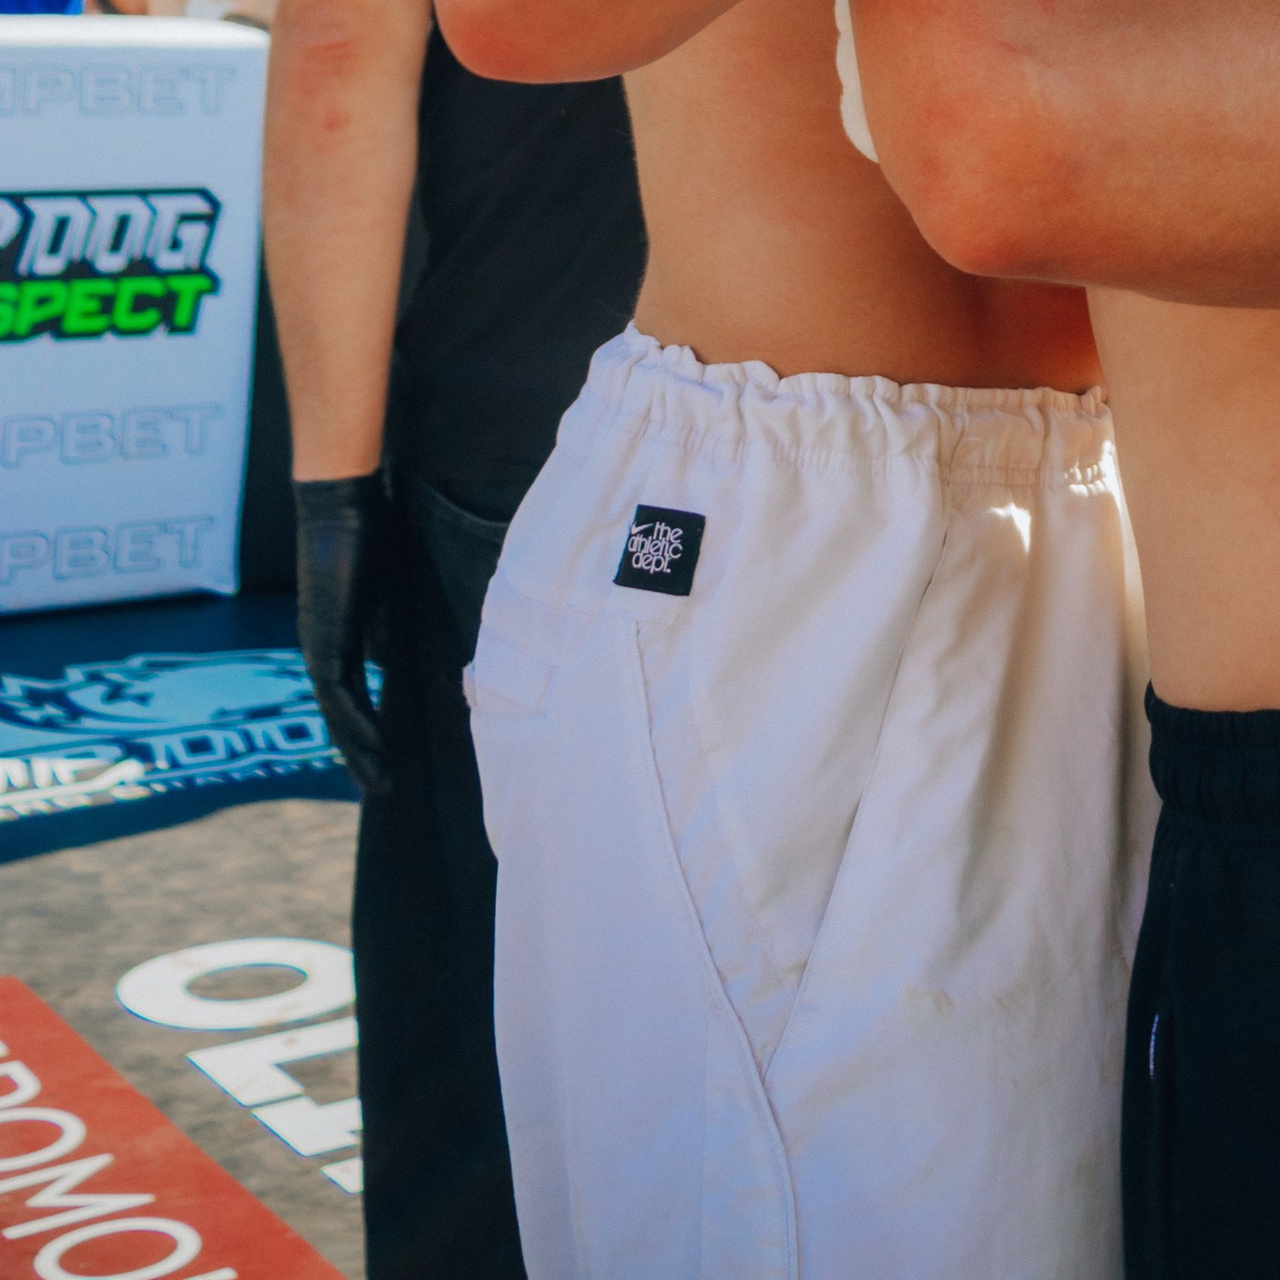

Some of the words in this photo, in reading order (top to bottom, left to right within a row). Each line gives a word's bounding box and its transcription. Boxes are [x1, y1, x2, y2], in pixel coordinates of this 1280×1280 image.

[16, 192, 216, 279] DOG
[653, 521, 684, 543] the
[628, 533, 684, 559] athletic
[631, 551, 672, 574] dept.
